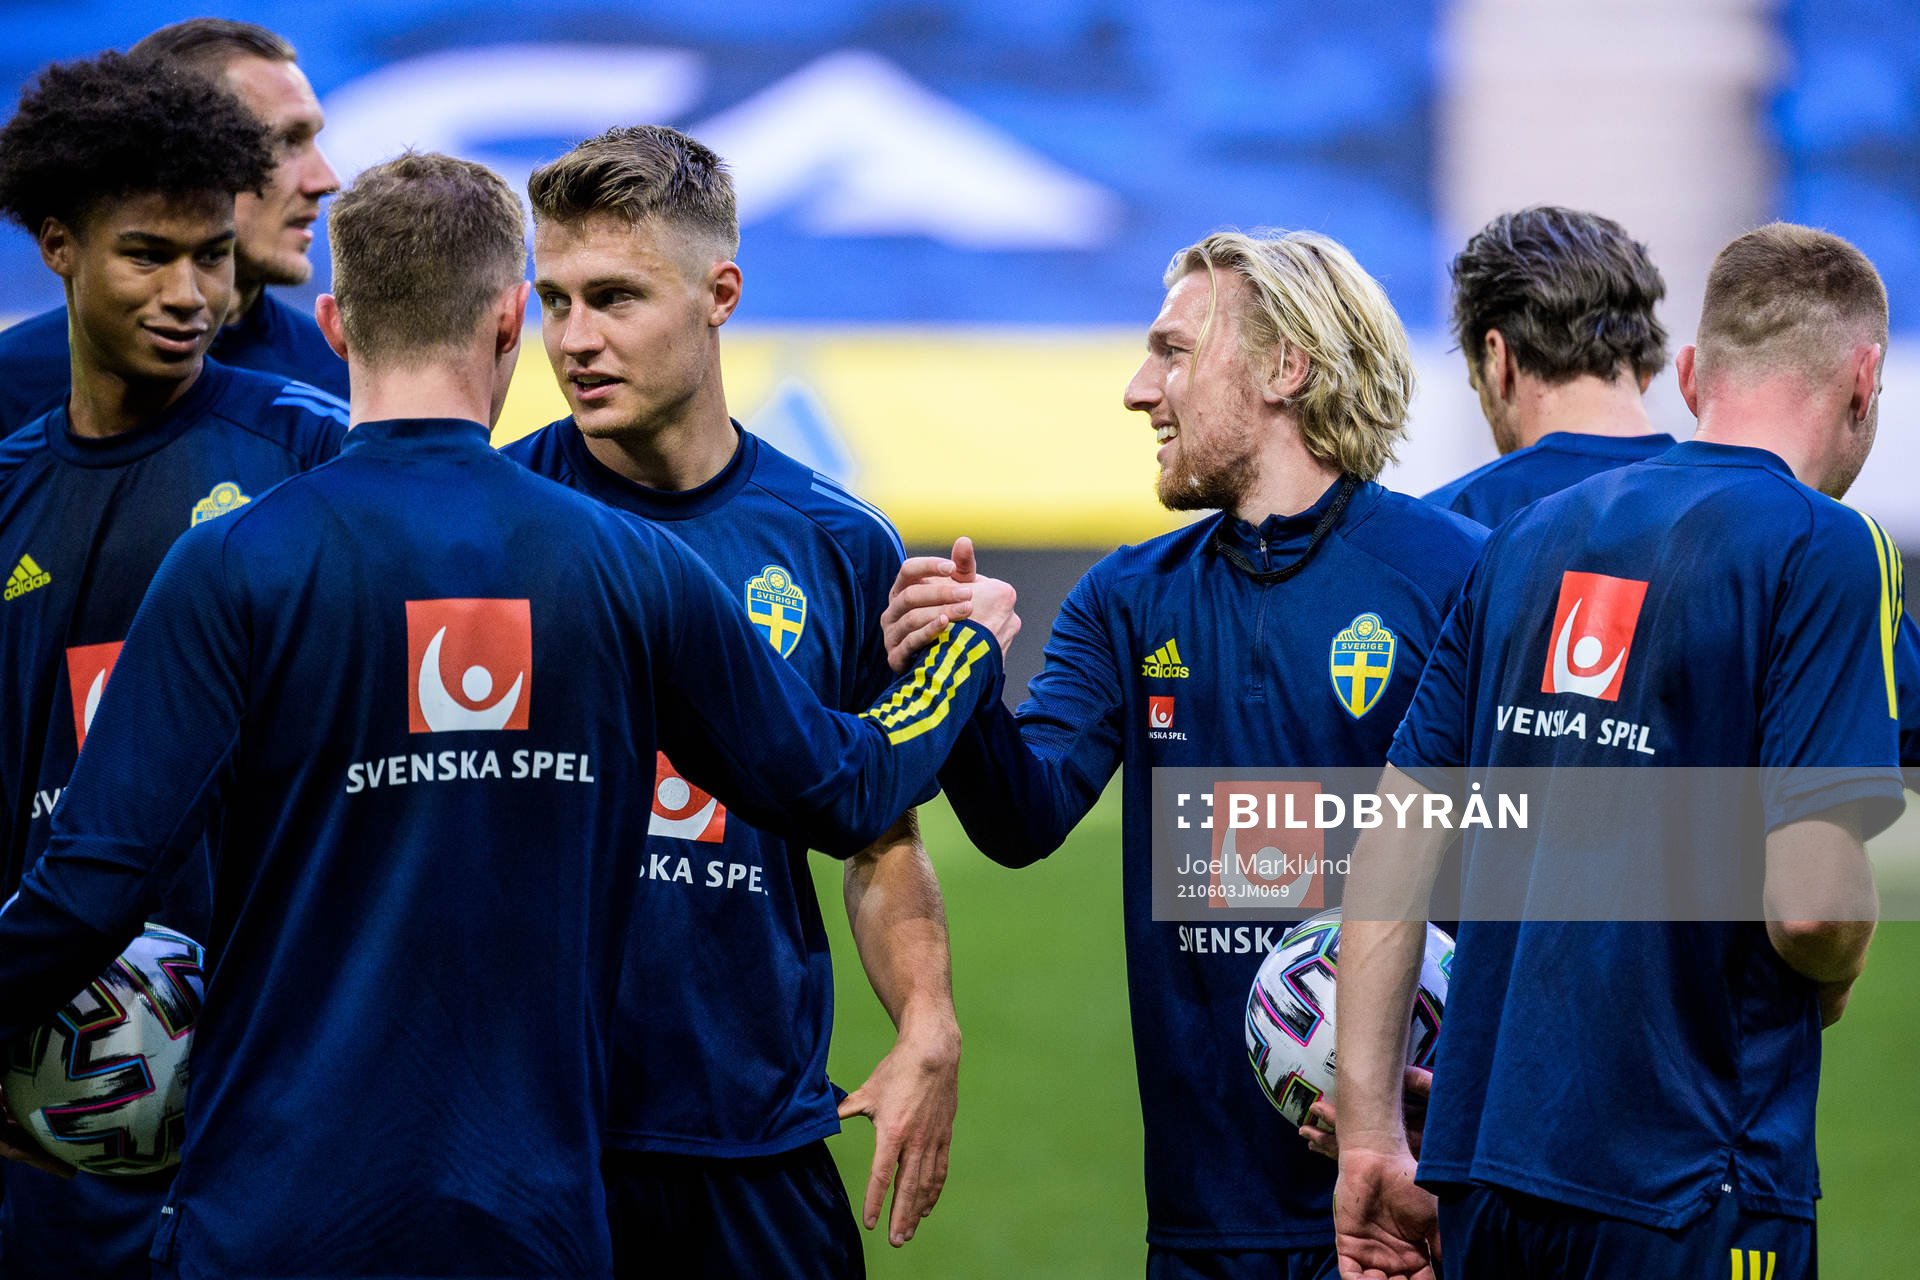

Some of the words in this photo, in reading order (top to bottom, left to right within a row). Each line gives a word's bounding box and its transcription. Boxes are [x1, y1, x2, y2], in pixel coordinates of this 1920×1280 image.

[4, 572, 51, 601] adidas
[756, 591, 798, 607] SVERIGE
[1341, 642, 1384, 651] SVERIGE
[1168, 731, 1188, 741] SPEL
[1597, 718, 1656, 755] SPEL
[346, 750, 502, 793] SVENSKA
[511, 749, 595, 783] SPEL
[31, 787, 66, 819] SV
[639, 853, 694, 884] KA
[705, 861, 768, 895] SPE
